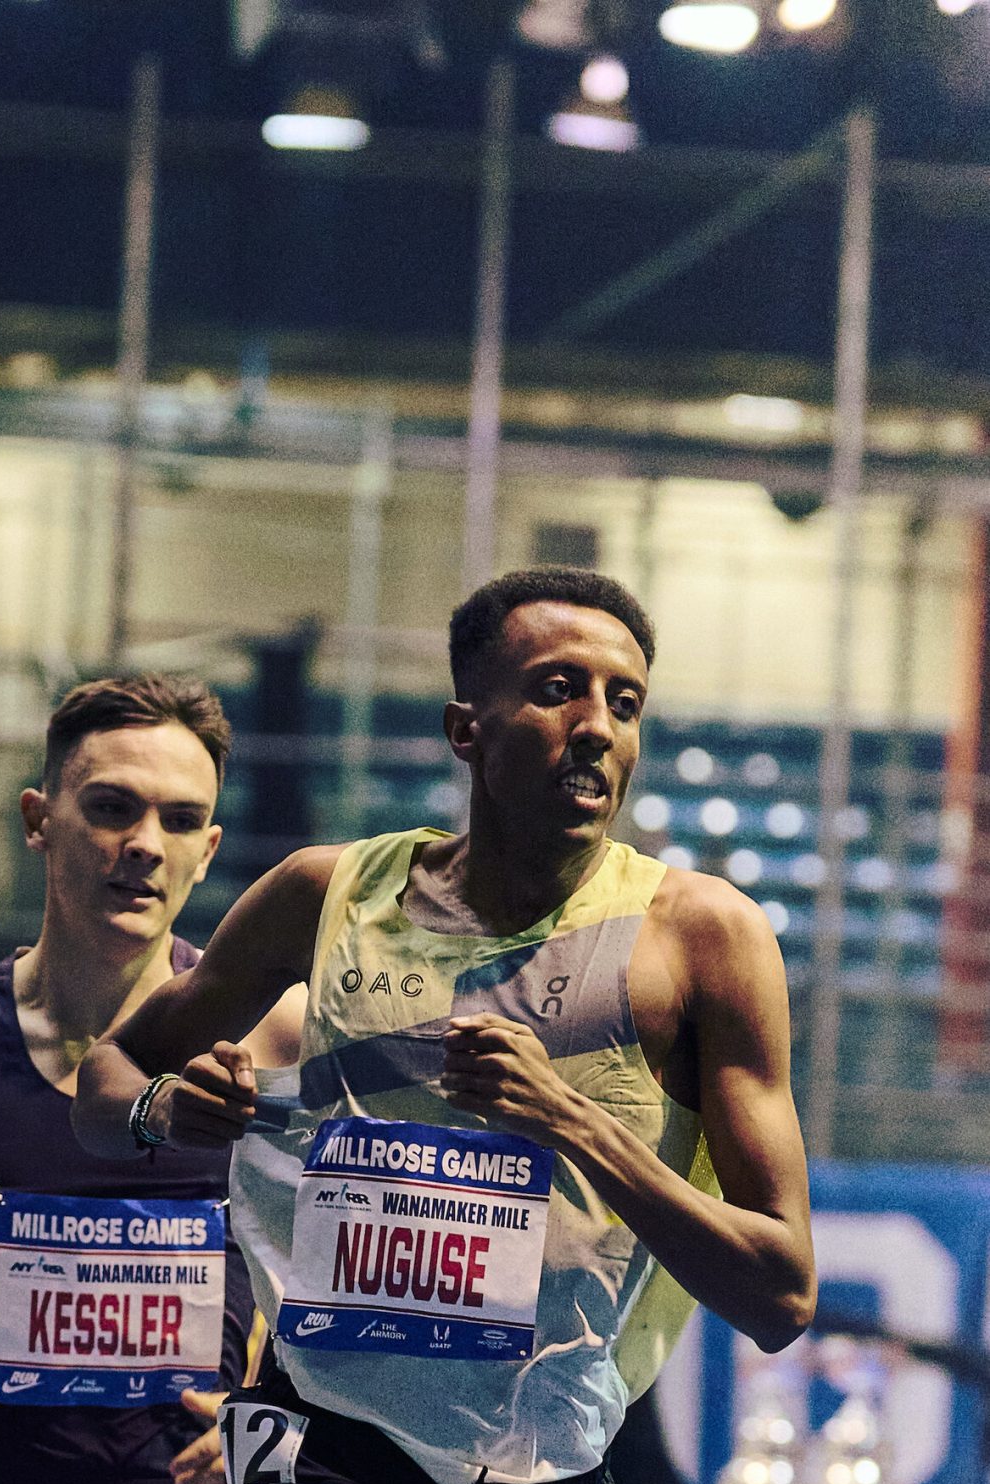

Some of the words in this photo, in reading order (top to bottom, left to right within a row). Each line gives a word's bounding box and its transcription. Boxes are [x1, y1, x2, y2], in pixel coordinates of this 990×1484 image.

[342, 967, 425, 998] OAC
[321, 1137, 437, 1175] MILLROSE
[441, 1148, 532, 1187] GAMES
[382, 1191, 488, 1226] WANAMAKER
[491, 1208, 530, 1231] MILE
[11, 1211, 123, 1244] MILLROSE
[127, 1217, 208, 1246] GAMES
[76, 1262, 171, 1285] WANAMAKER
[176, 1265, 208, 1285] MILE
[331, 1221, 491, 1308] NUGUSE
[28, 1289, 183, 1357] KESSLER
[304, 1311, 335, 1327] RUN
[380, 1323, 397, 1332] THE
[370, 1330, 407, 1341] ARMORY
[10, 1370, 41, 1384] RUN
